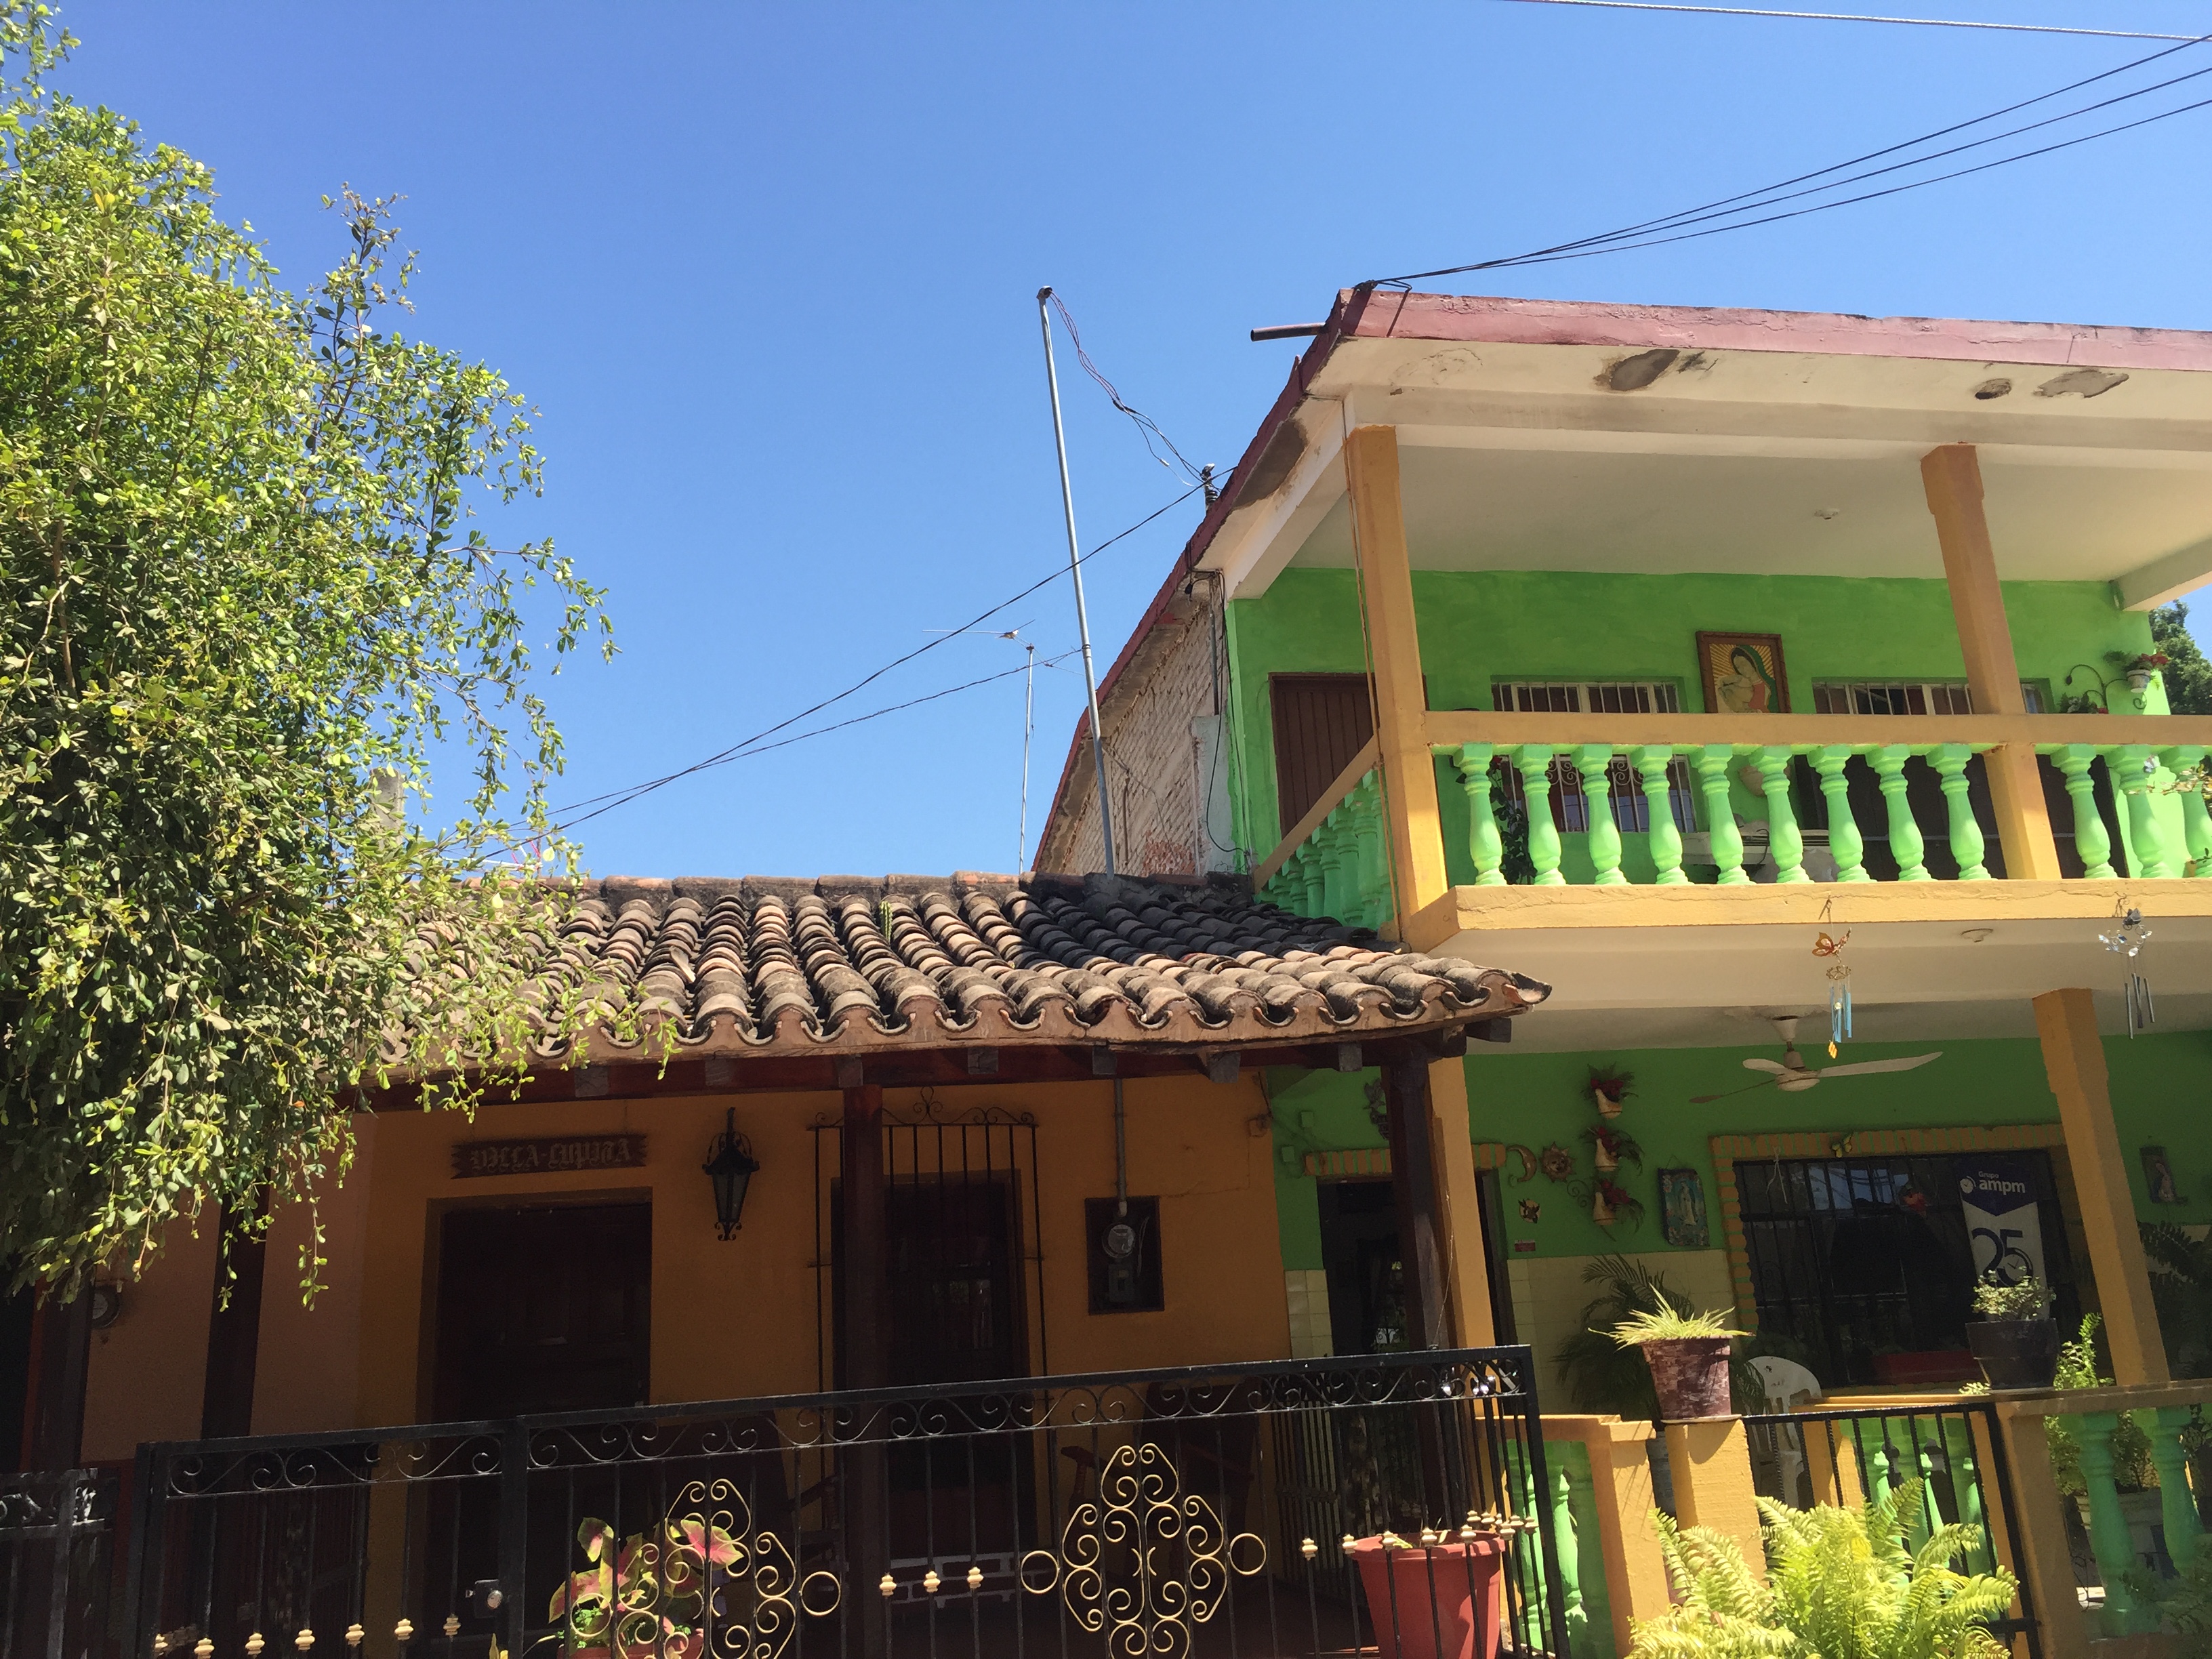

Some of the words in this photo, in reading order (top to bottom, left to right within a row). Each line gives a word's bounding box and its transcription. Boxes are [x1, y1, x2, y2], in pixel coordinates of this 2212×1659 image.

[1978, 1171, 1999, 1179] Grupo
[1979, 1179, 2026, 1195] ampm
[1971, 1227, 2033, 1288] 25
